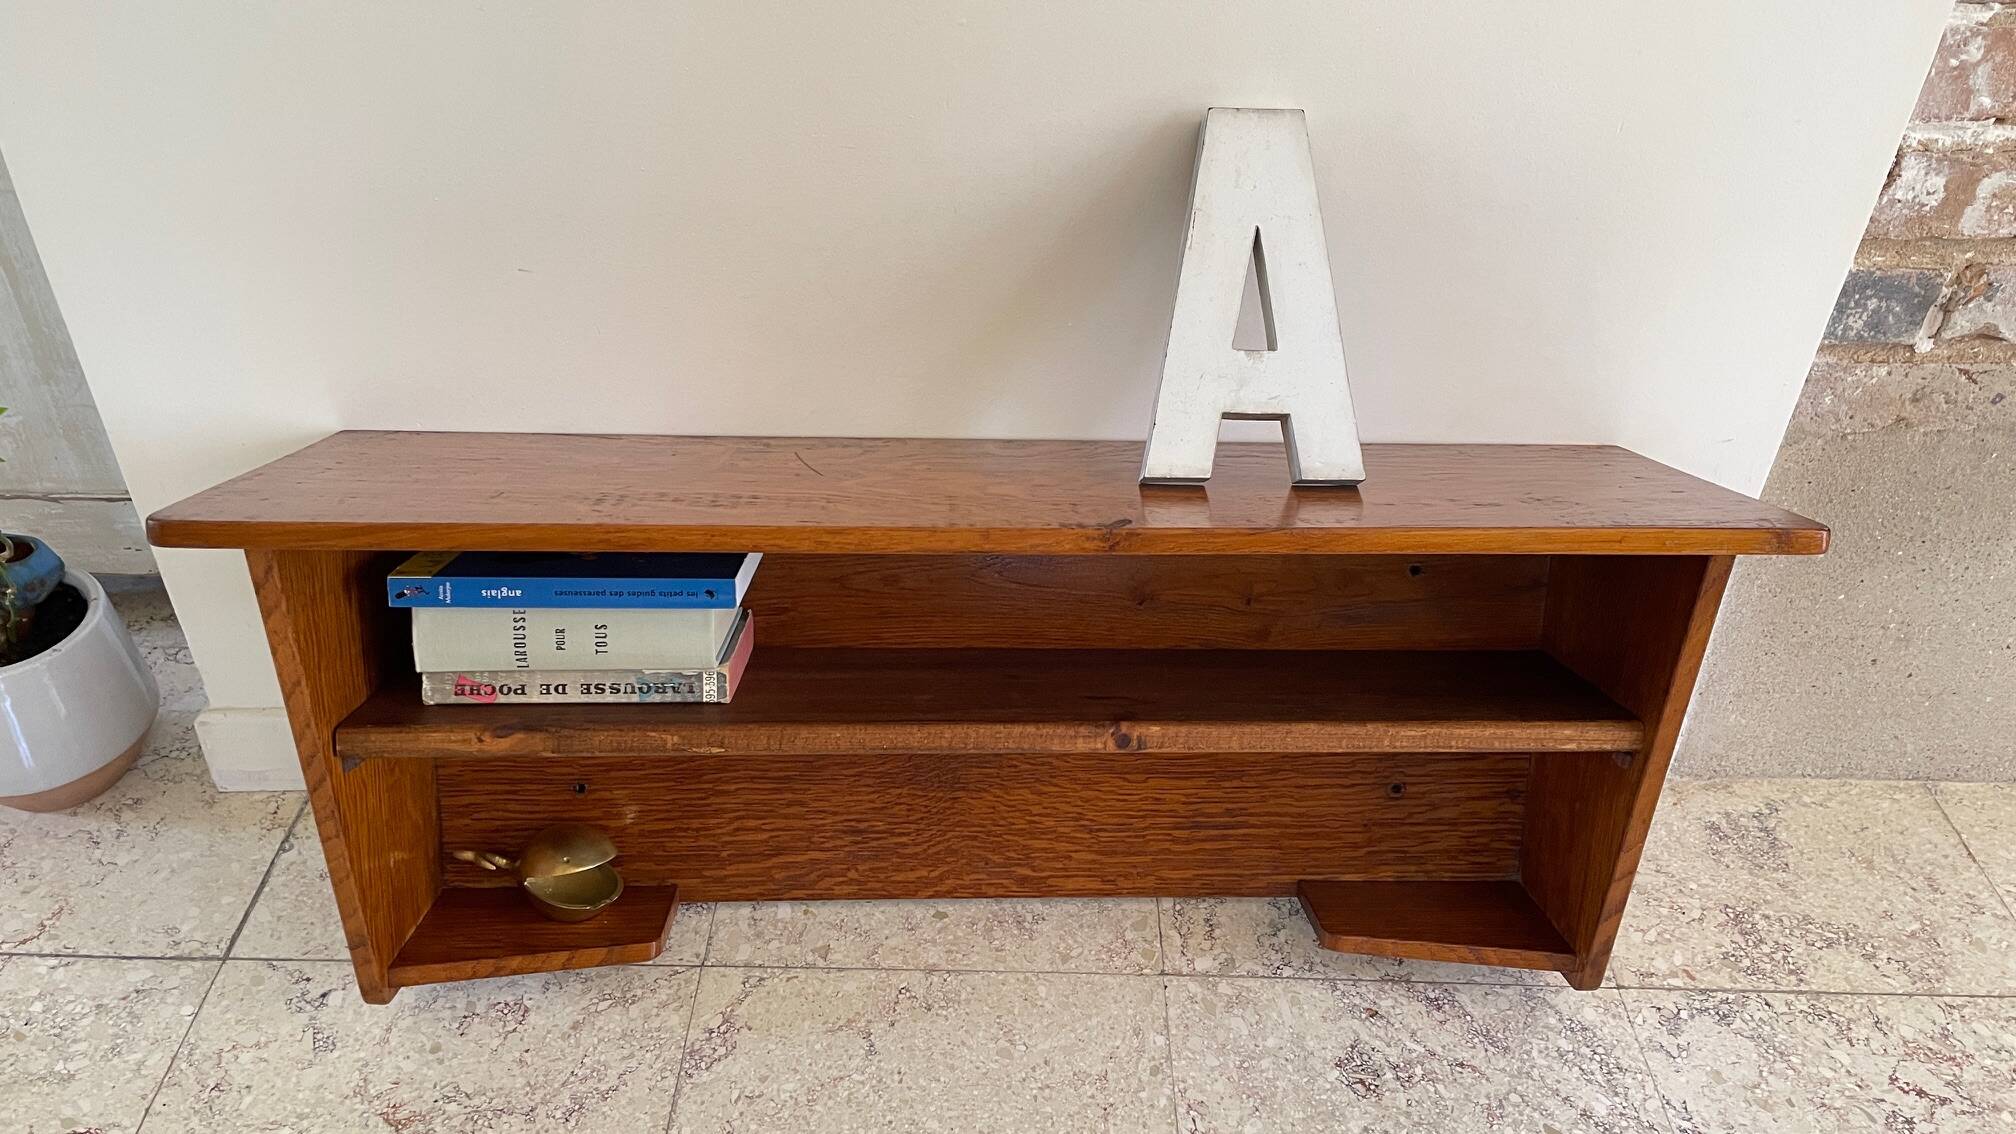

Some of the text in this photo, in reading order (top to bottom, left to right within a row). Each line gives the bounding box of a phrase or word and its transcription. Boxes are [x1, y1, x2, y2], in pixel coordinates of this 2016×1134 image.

[1139, 107, 1366, 486] A
[482, 587, 522, 599] anglais
[554, 588, 698, 598] les petits guides des paresseuses
[512, 610, 529, 668] LAROUSSE
[555, 628, 566, 651] POUR
[594, 624, 608, 655] TOUS
[454, 683, 696, 697] LAROUSSE DE POCHE
